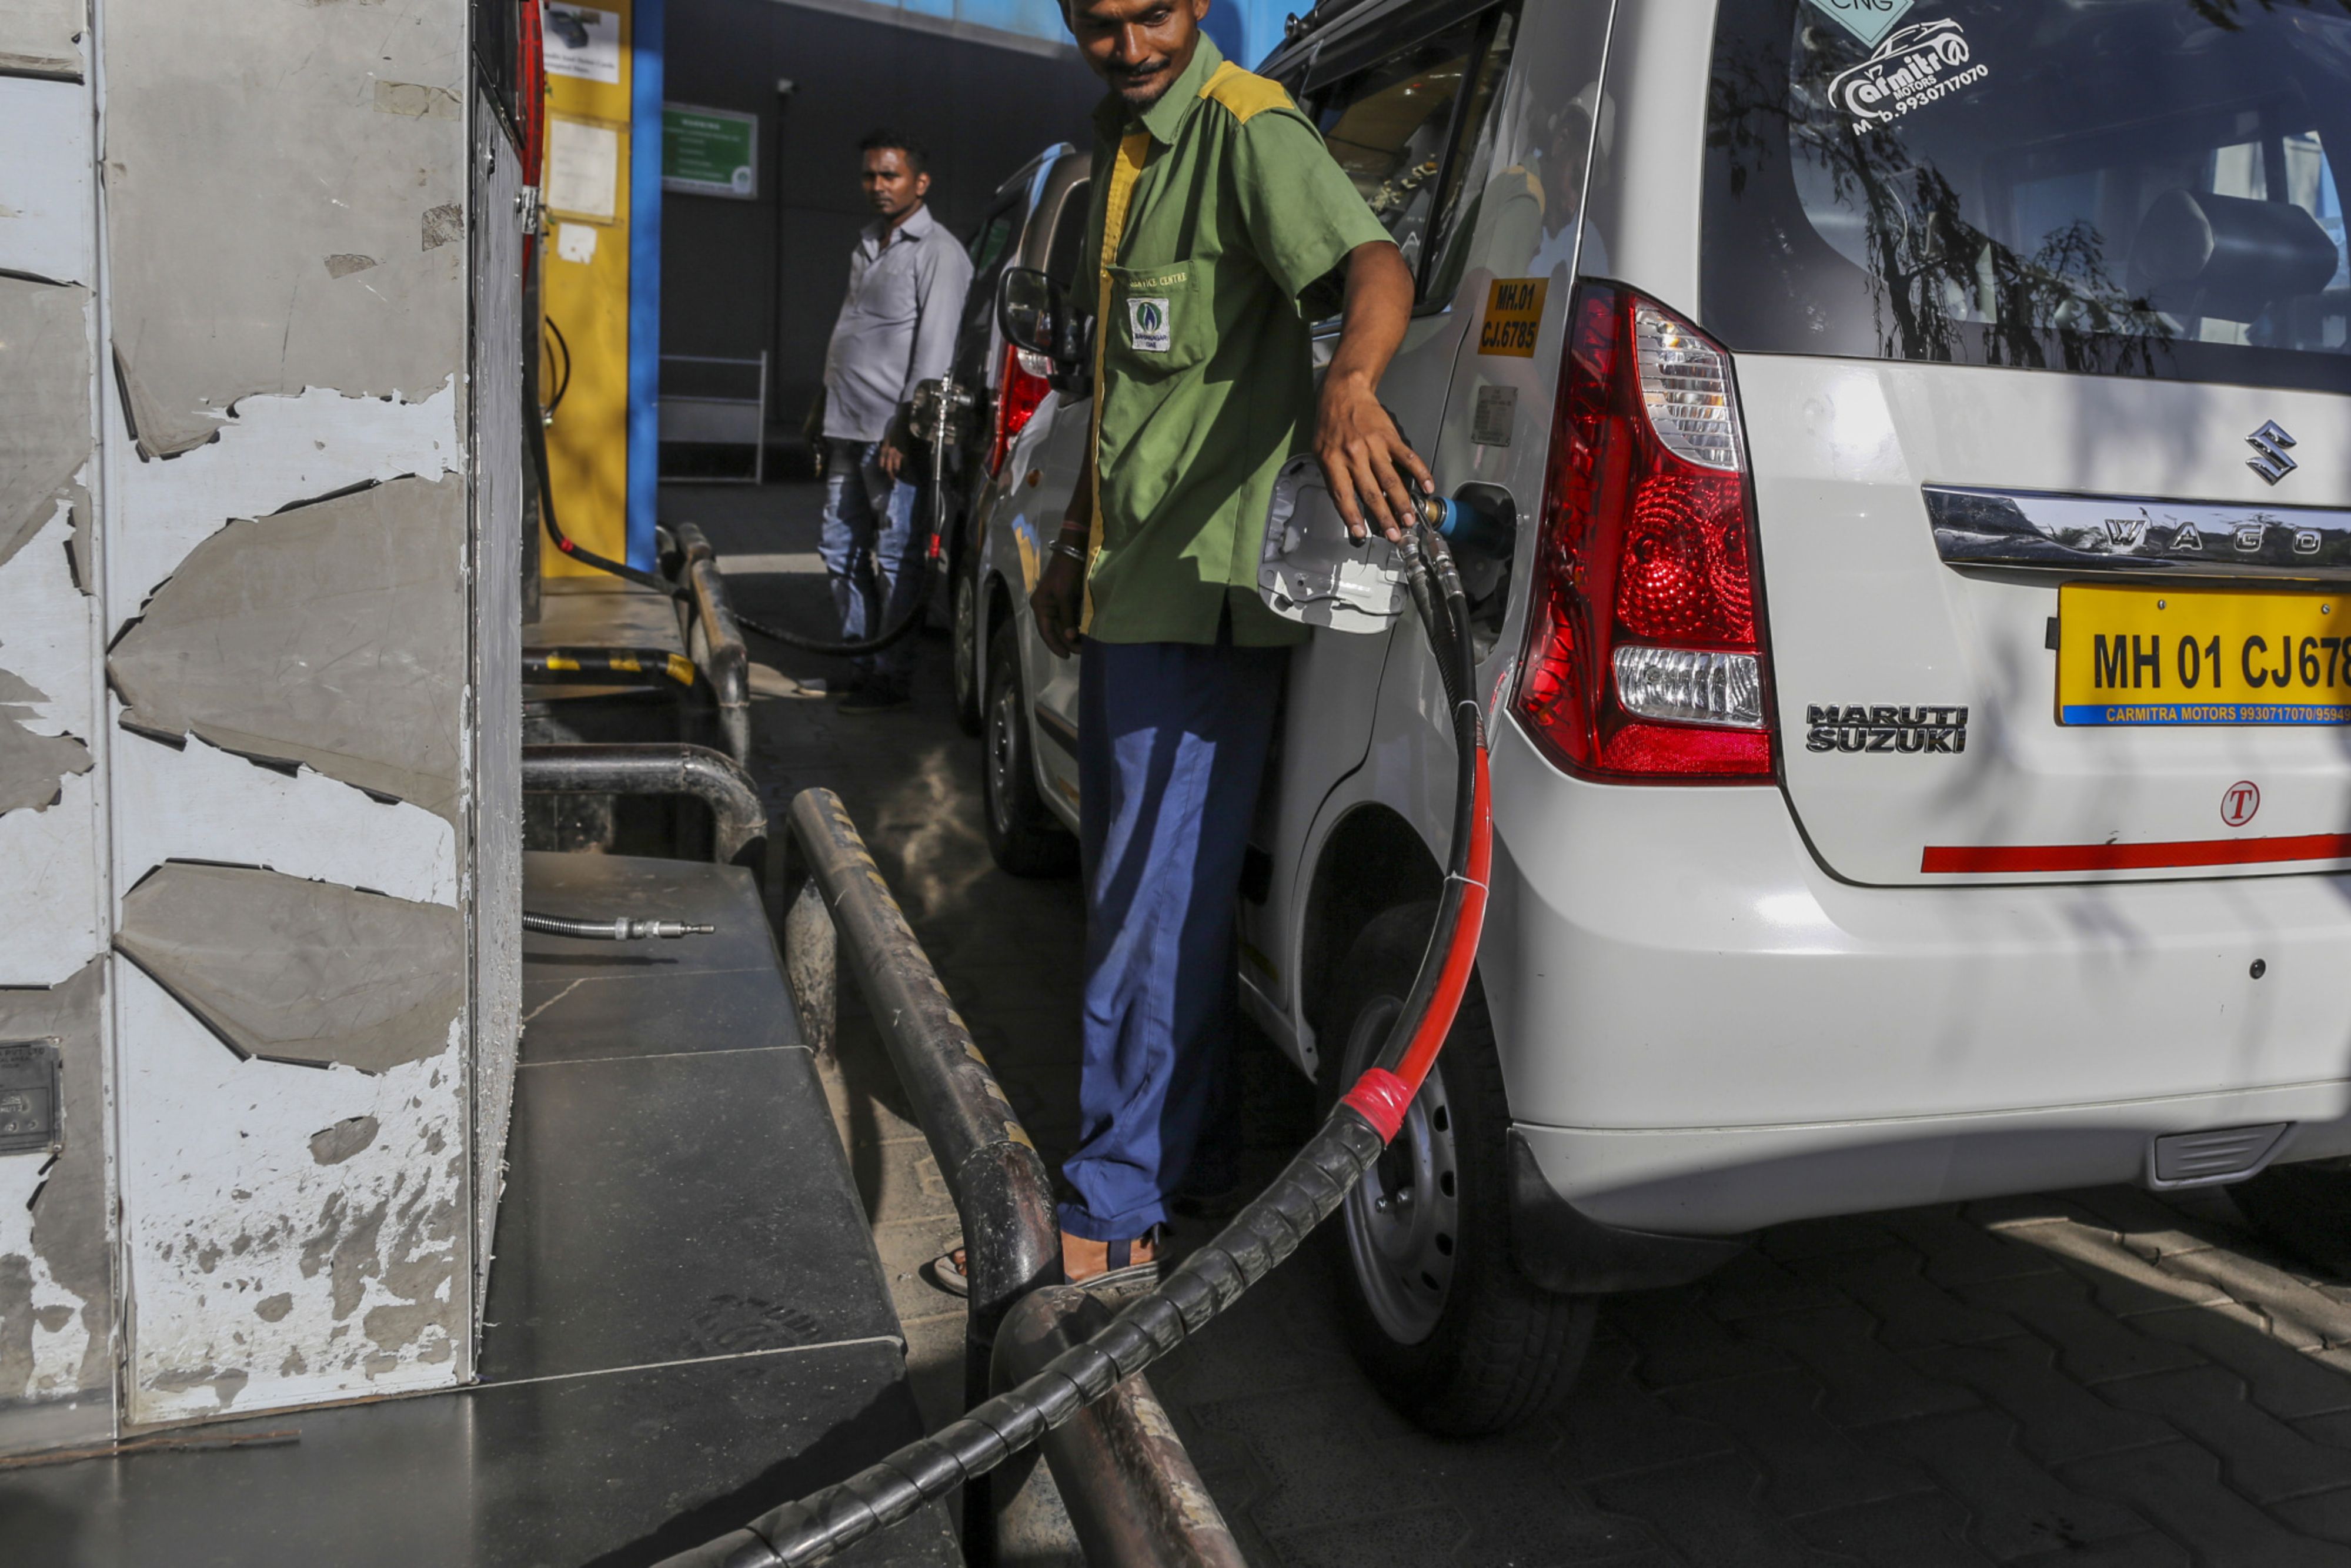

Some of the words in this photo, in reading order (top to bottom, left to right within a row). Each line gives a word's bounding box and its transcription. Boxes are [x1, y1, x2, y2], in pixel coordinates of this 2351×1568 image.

[1893, 74, 1937, 101] MOTORS
[1160, 272, 1187, 286] CENTRE
[1495, 283, 1536, 311] MH.01
[1481, 321, 1537, 347] CJ.6785
[2093, 634, 2161, 688] MH
[2178, 635, 2222, 689] 01
[1806, 704, 1969, 725] MARUTI
[2106, 707, 2178, 722] CARMITRA
[2181, 707, 2236, 720] MOTORS
[1805, 726, 1967, 754] SUZUKI
